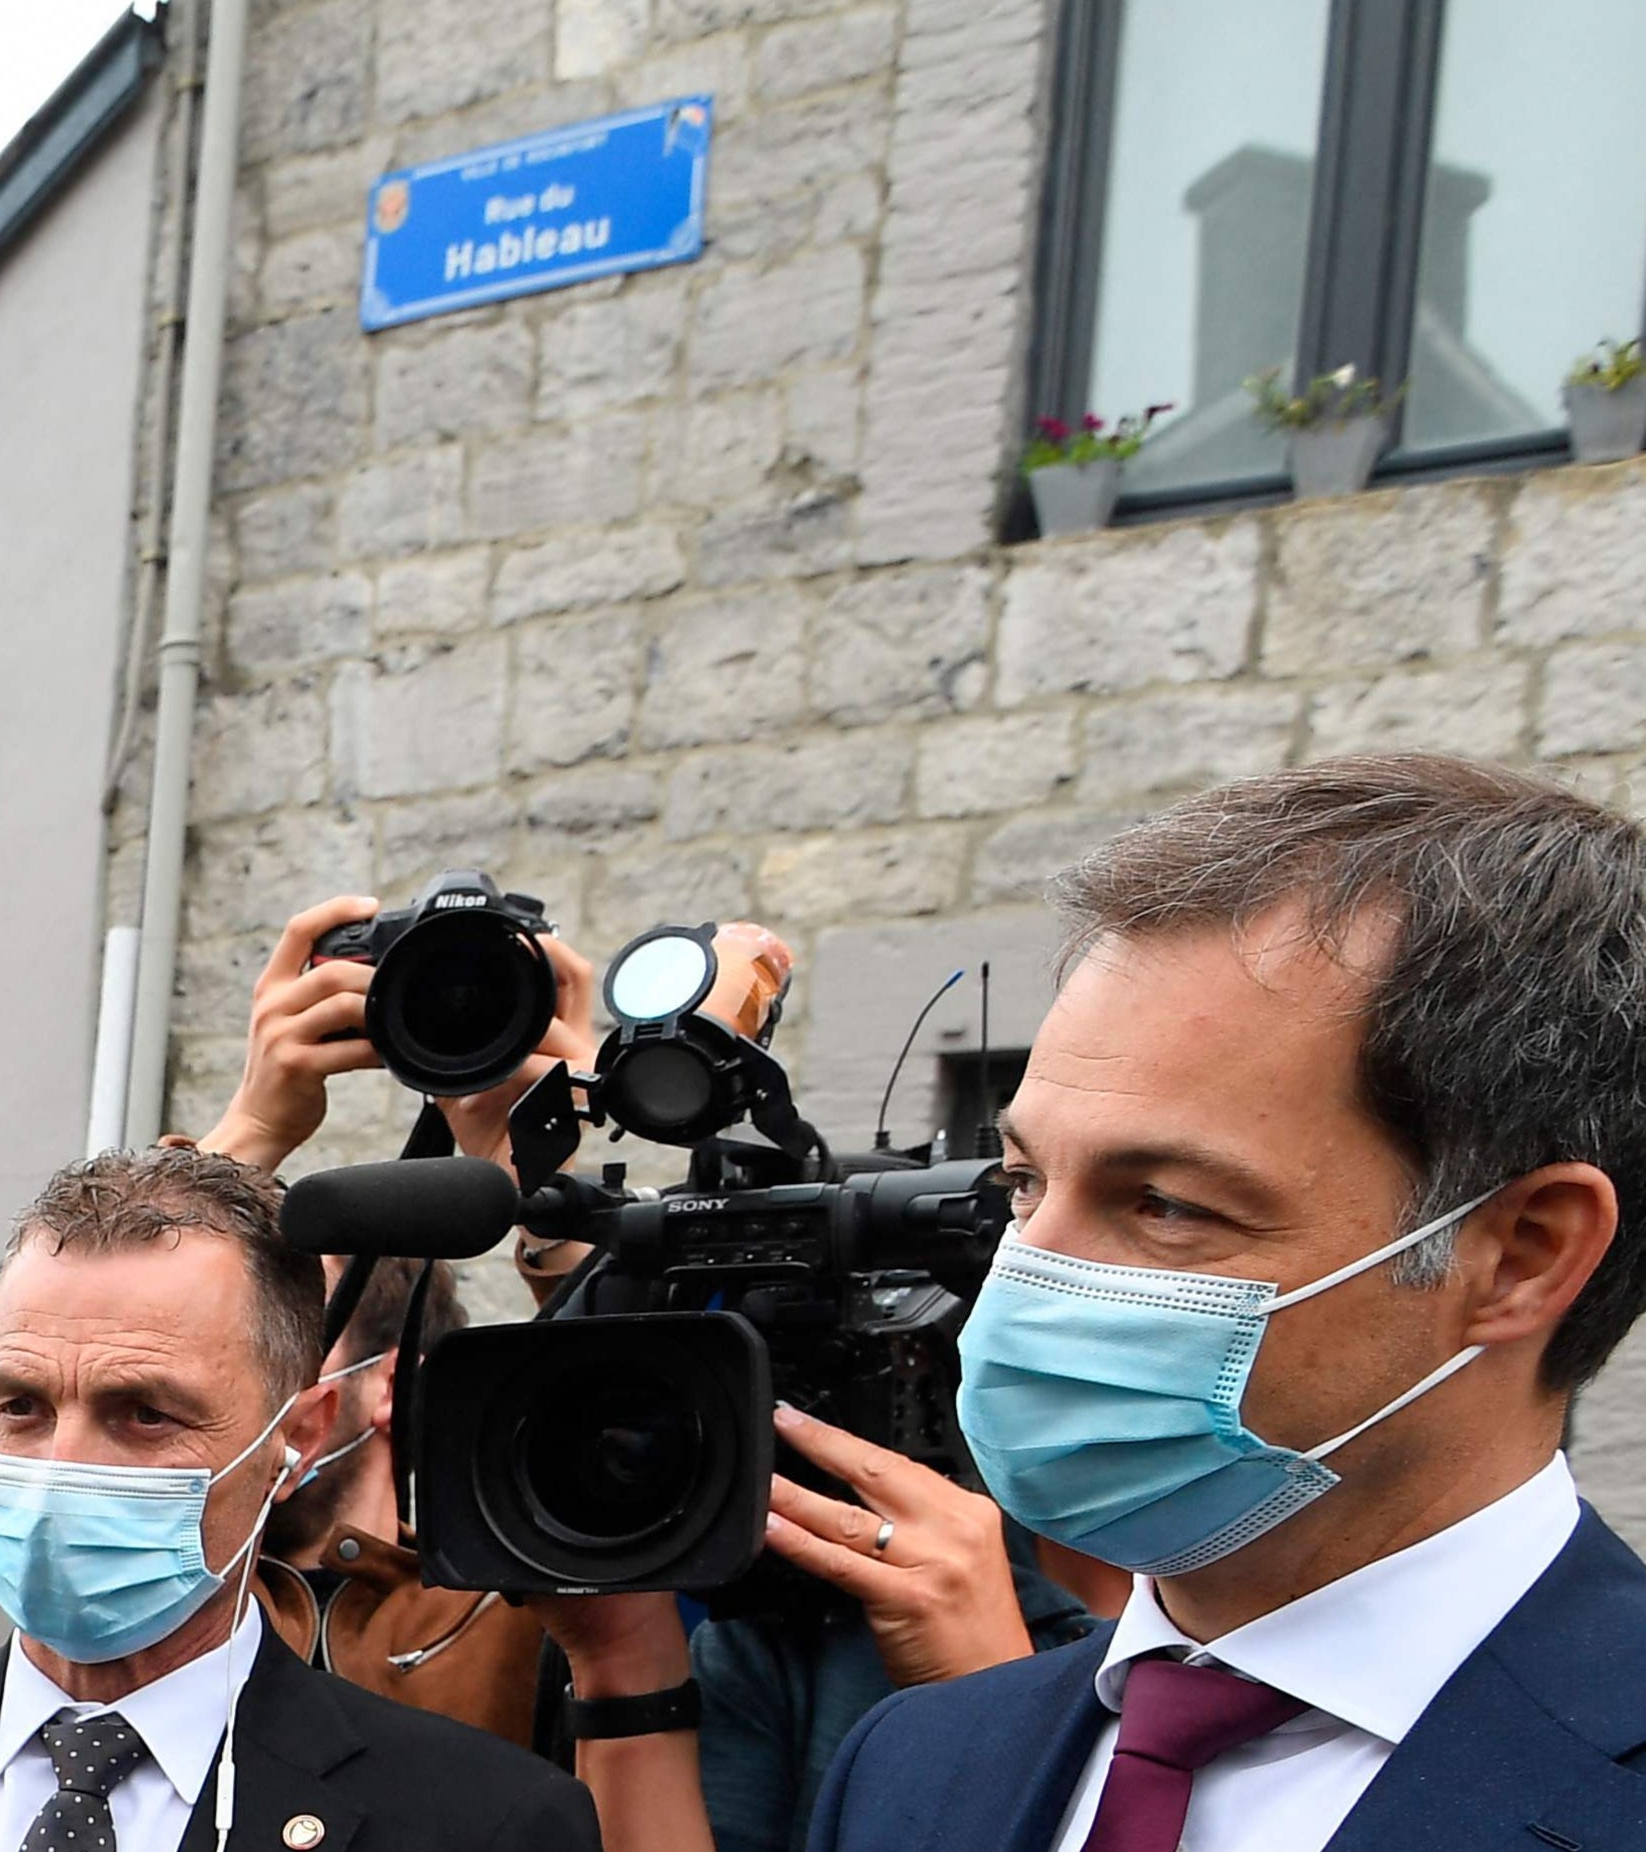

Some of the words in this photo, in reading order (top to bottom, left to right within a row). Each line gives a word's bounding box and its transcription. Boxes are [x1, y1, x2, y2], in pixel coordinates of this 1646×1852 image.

[485, 196, 535, 224] Rue
[539, 182, 576, 213] du
[445, 218, 610, 280] Hableau
[435, 893, 487, 909] Nikon
[668, 1198, 730, 1213] SONY
